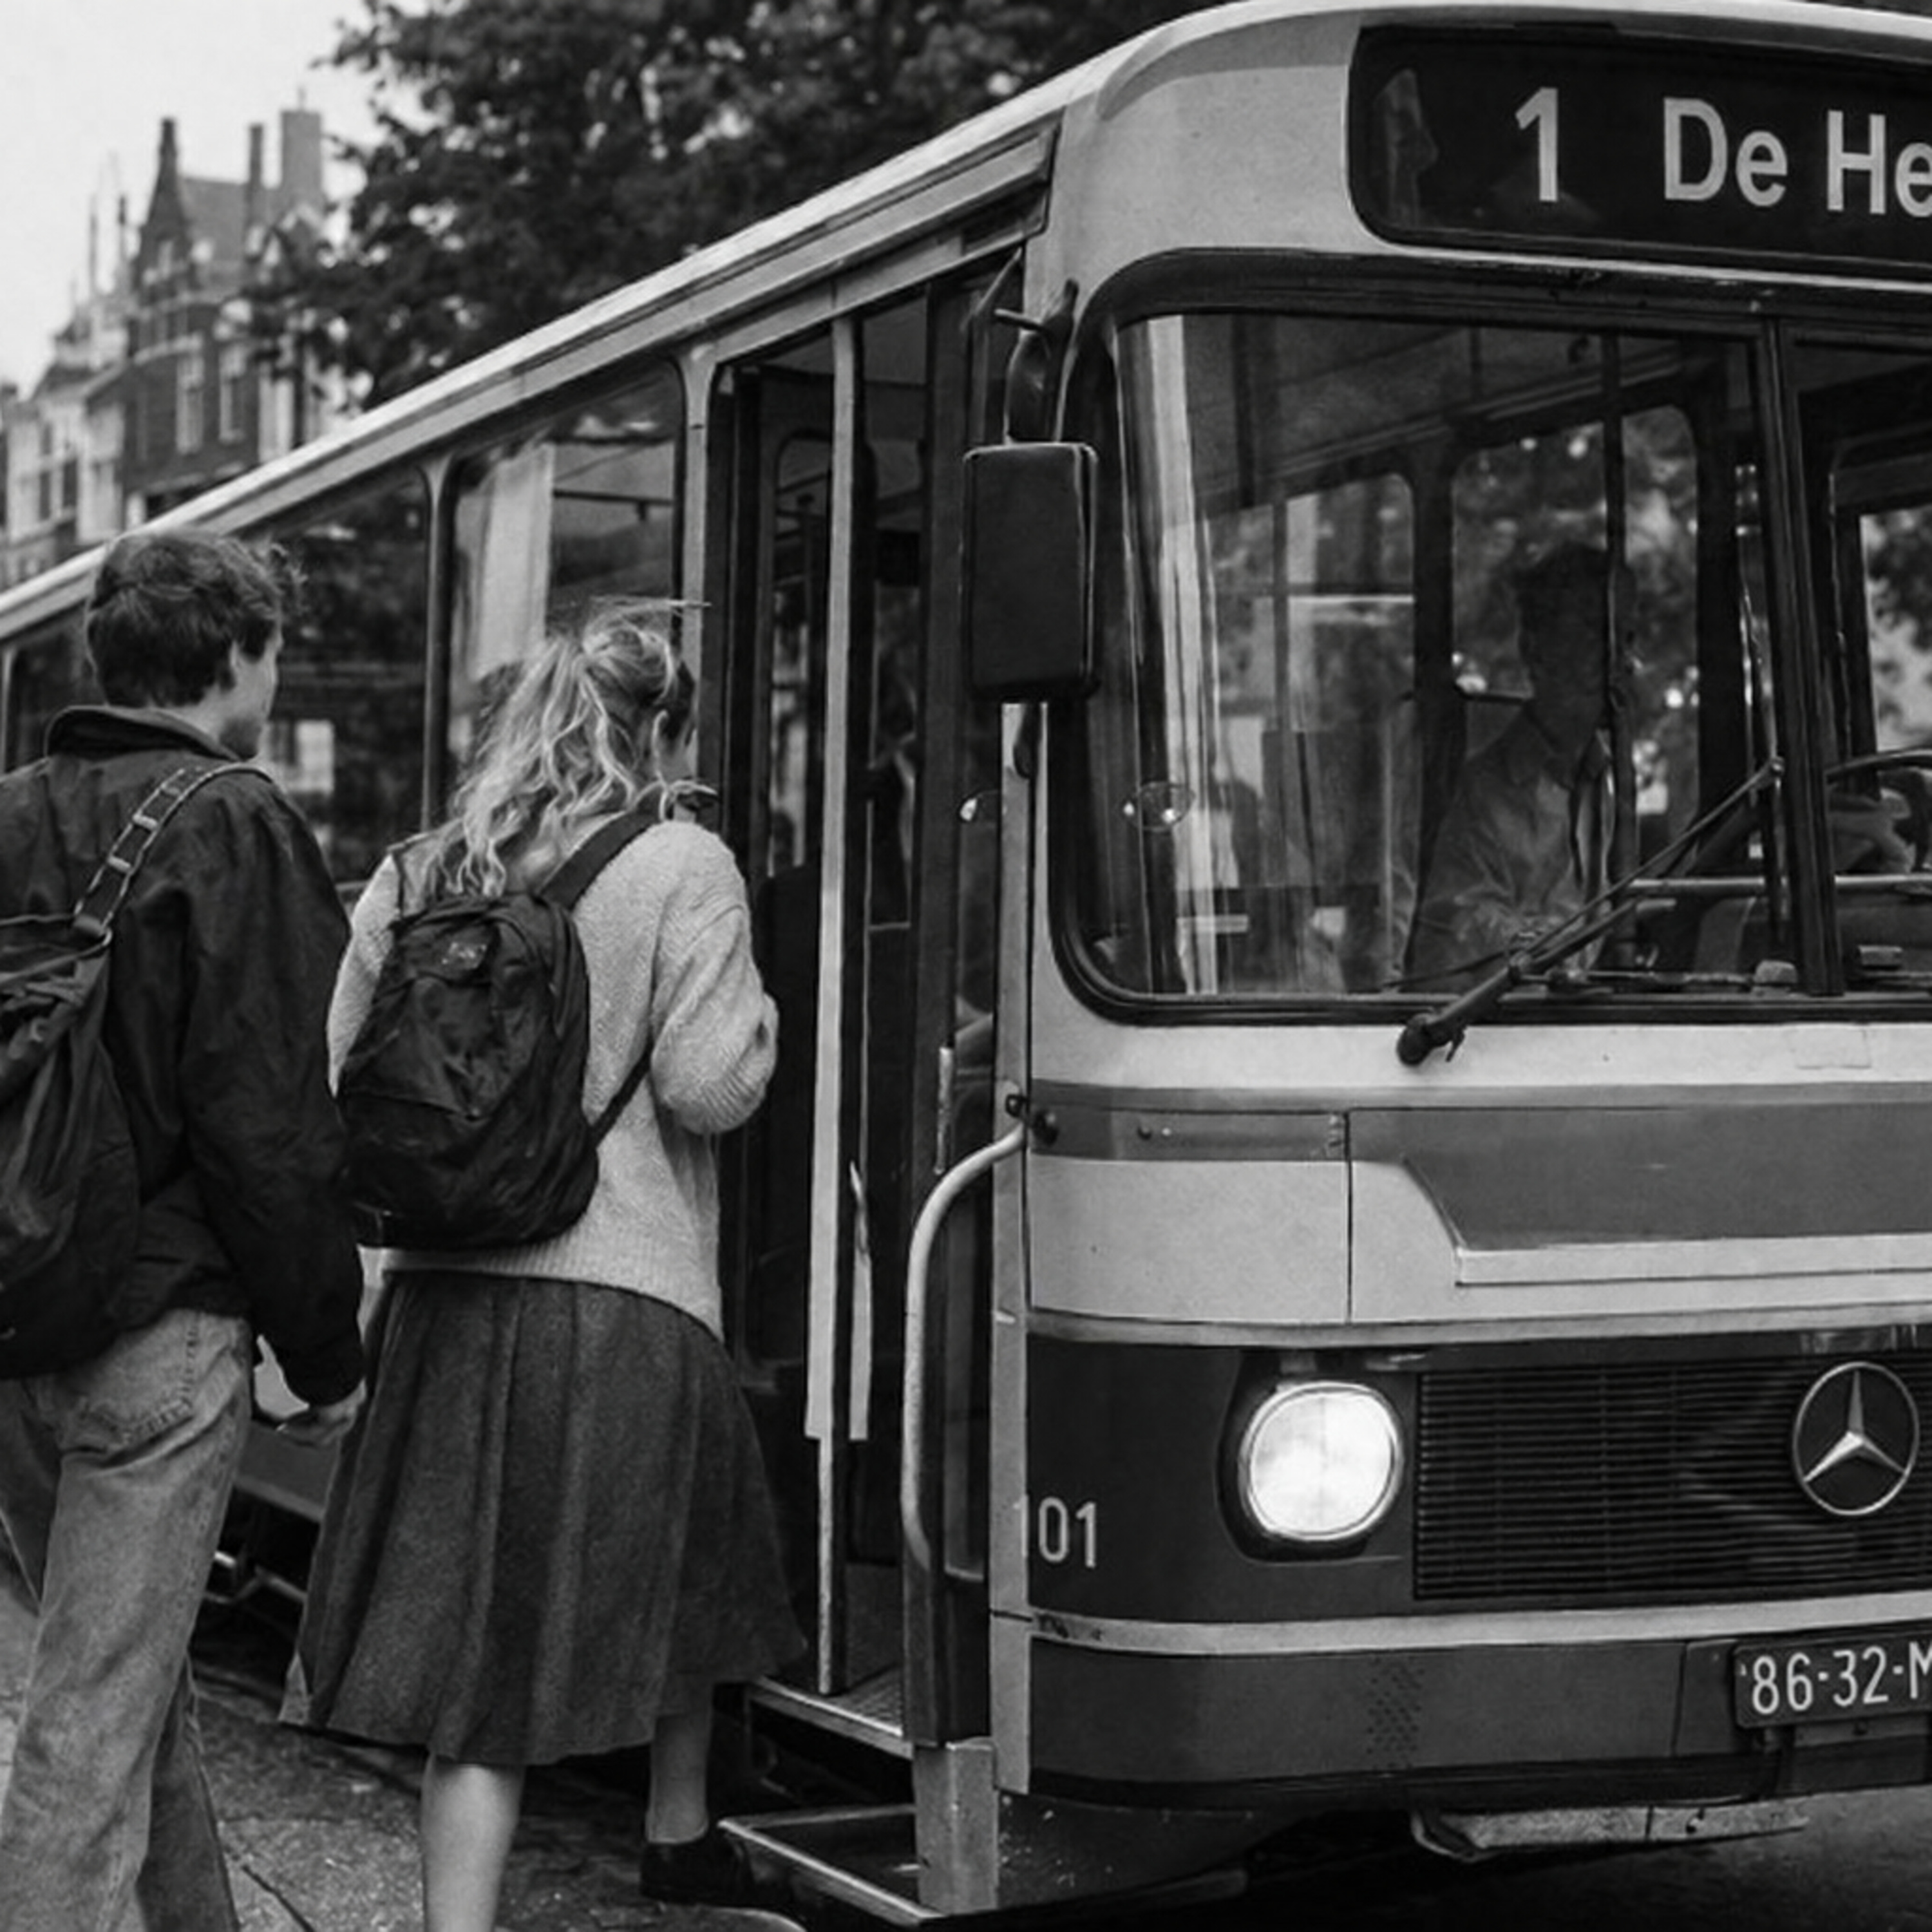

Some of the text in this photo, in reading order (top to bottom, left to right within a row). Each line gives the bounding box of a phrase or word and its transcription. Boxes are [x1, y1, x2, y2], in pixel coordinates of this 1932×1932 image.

[1515, 88, 1932, 218] 1 De He
[1021, 1493, 1096, 1568] 01
